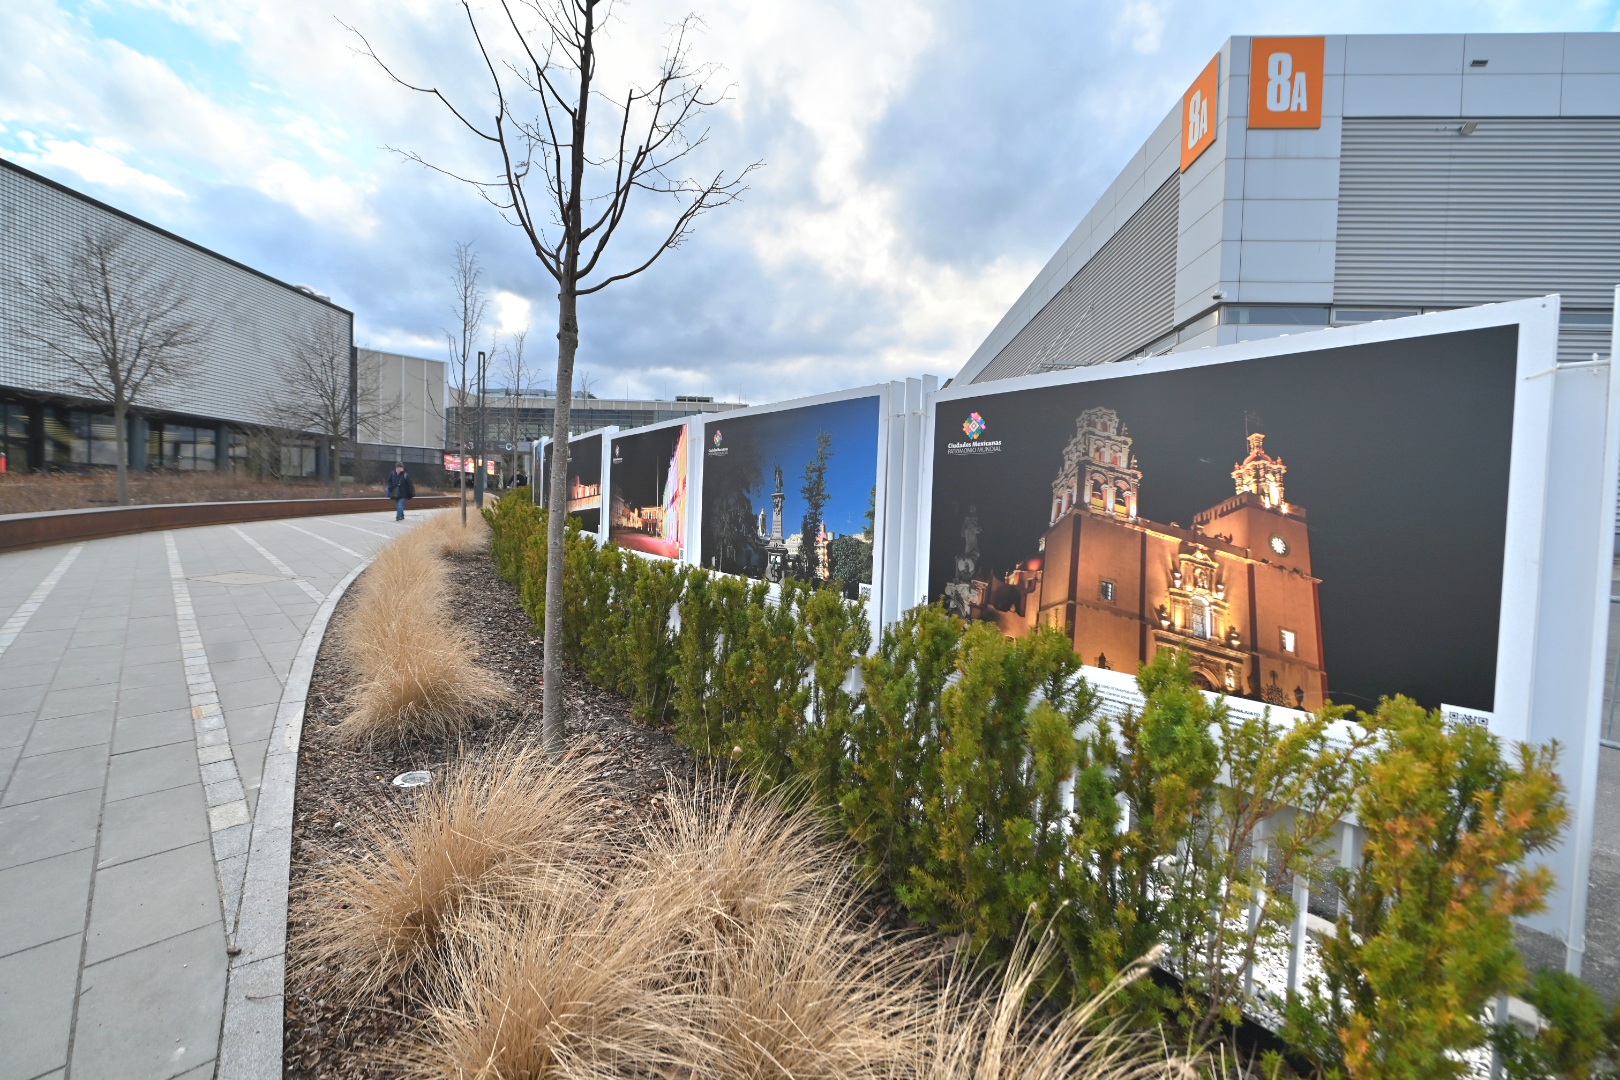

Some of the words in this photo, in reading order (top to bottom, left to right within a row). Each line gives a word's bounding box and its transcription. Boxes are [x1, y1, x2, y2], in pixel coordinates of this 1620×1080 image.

[1265, 52, 1308, 112] 8A
[1187, 88, 1208, 151] 8A
[947, 447, 977, 455] PATRIMONIO
